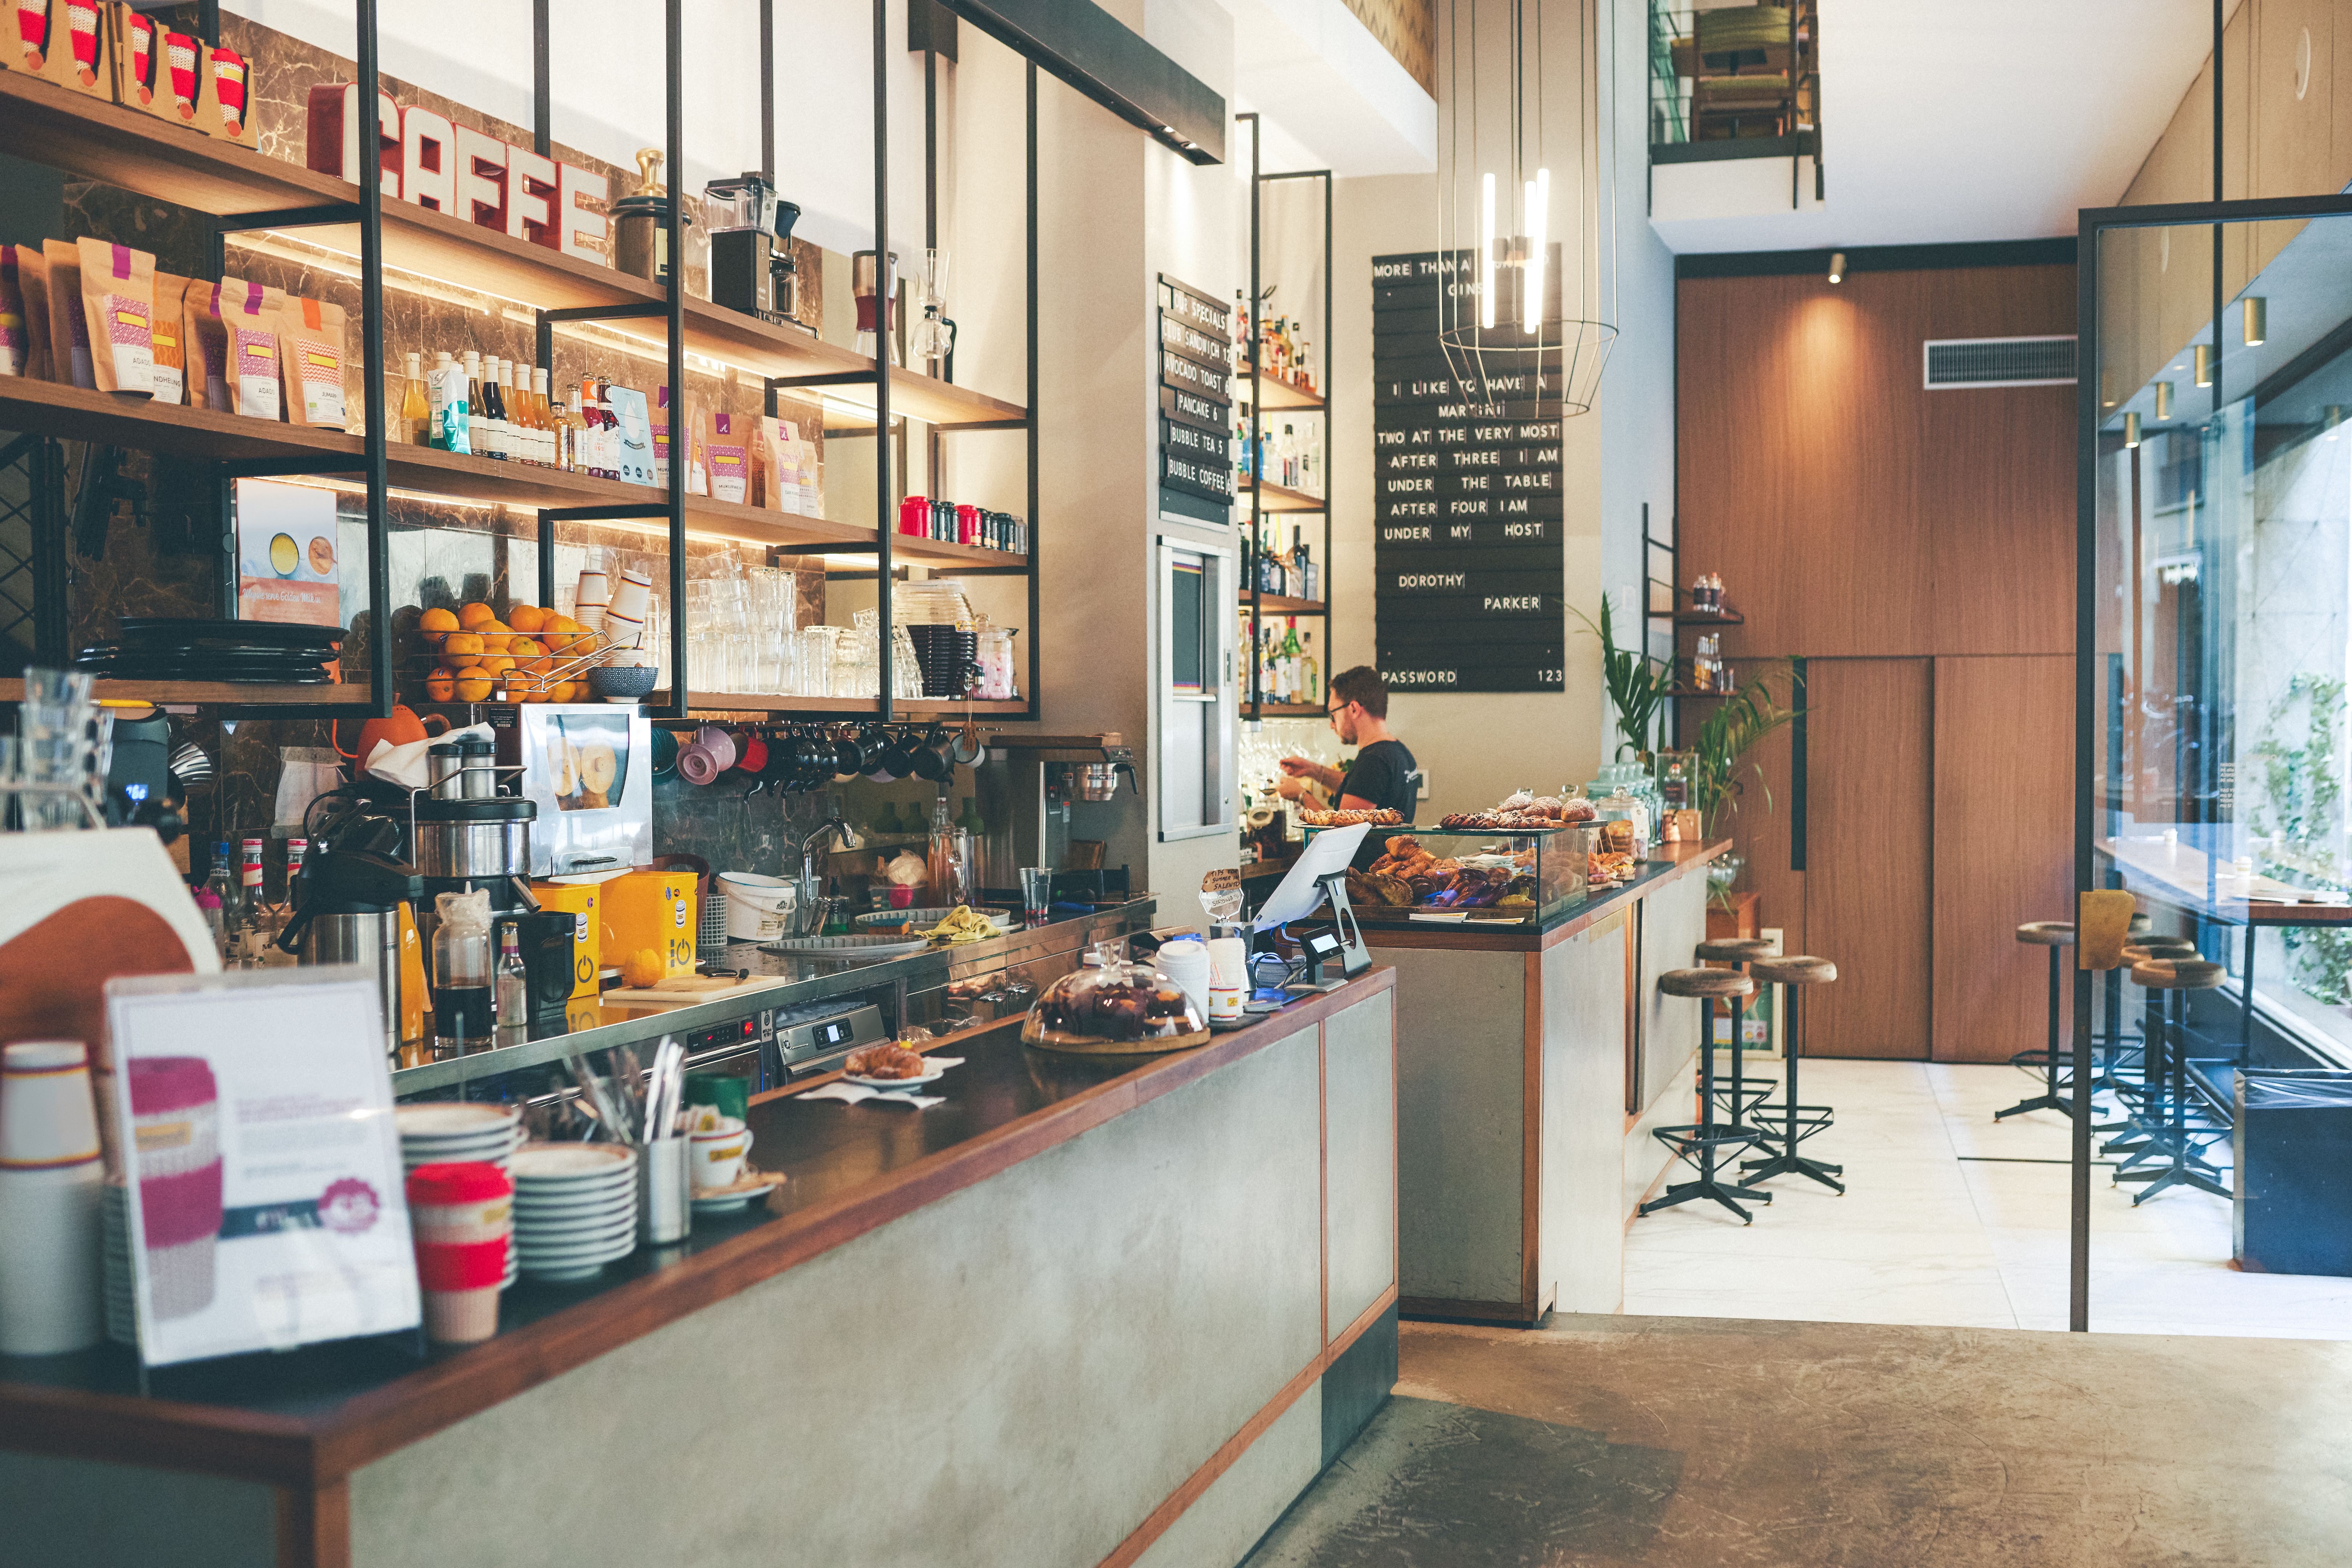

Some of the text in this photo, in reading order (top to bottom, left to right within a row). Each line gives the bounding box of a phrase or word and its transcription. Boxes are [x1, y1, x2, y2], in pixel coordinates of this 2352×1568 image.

[309, 82, 608, 268] CAFFE
[1373, 259, 1470, 278] MORE THAN A
[1175, 293, 1225, 331] OUR SPECIALS
[1162, 321, 1181, 342] CLUB
[1185, 331, 1220, 358] SANDWICH
[133, 357, 151, 366] ADADO
[154, 376, 181, 387] NDHELING
[1165, 356, 1197, 381] AVOCADO
[1200, 369, 1222, 393] TOAST
[1393, 376, 1546, 395] I LIKE TO HAVE A
[1179, 394, 1217, 421] PANCAKE 6
[1438, 403, 1501, 418] MARTINI
[1172, 426, 1198, 448] BUBBLE
[1202, 436, 1216, 453] TEA
[1378, 424, 1558, 445] TWO AT THE VERY MOST
[1390, 449, 1557, 468] AFTER THREE I AM
[1169, 459, 1196, 481] BUBBLE
[1199, 469, 1225, 490] COFFEE
[1388, 474, 1549, 493] UNDER THE TABLE
[1391, 499, 1527, 516] AFTER FOUR I AM
[1384, 523, 1542, 540] UNDER MY HOST
[1399, 574, 1464, 588] DOROTHY
[266, 592, 279, 600] serve
[280, 591, 300, 602] Golden
[300, 592, 314, 603] Milk
[315, 594, 321, 604] in
[1484, 596, 1539, 610] PARKER
[1381, 670, 1457, 683] PASSWORD
[1213, 881, 1241, 890] SALENTO
